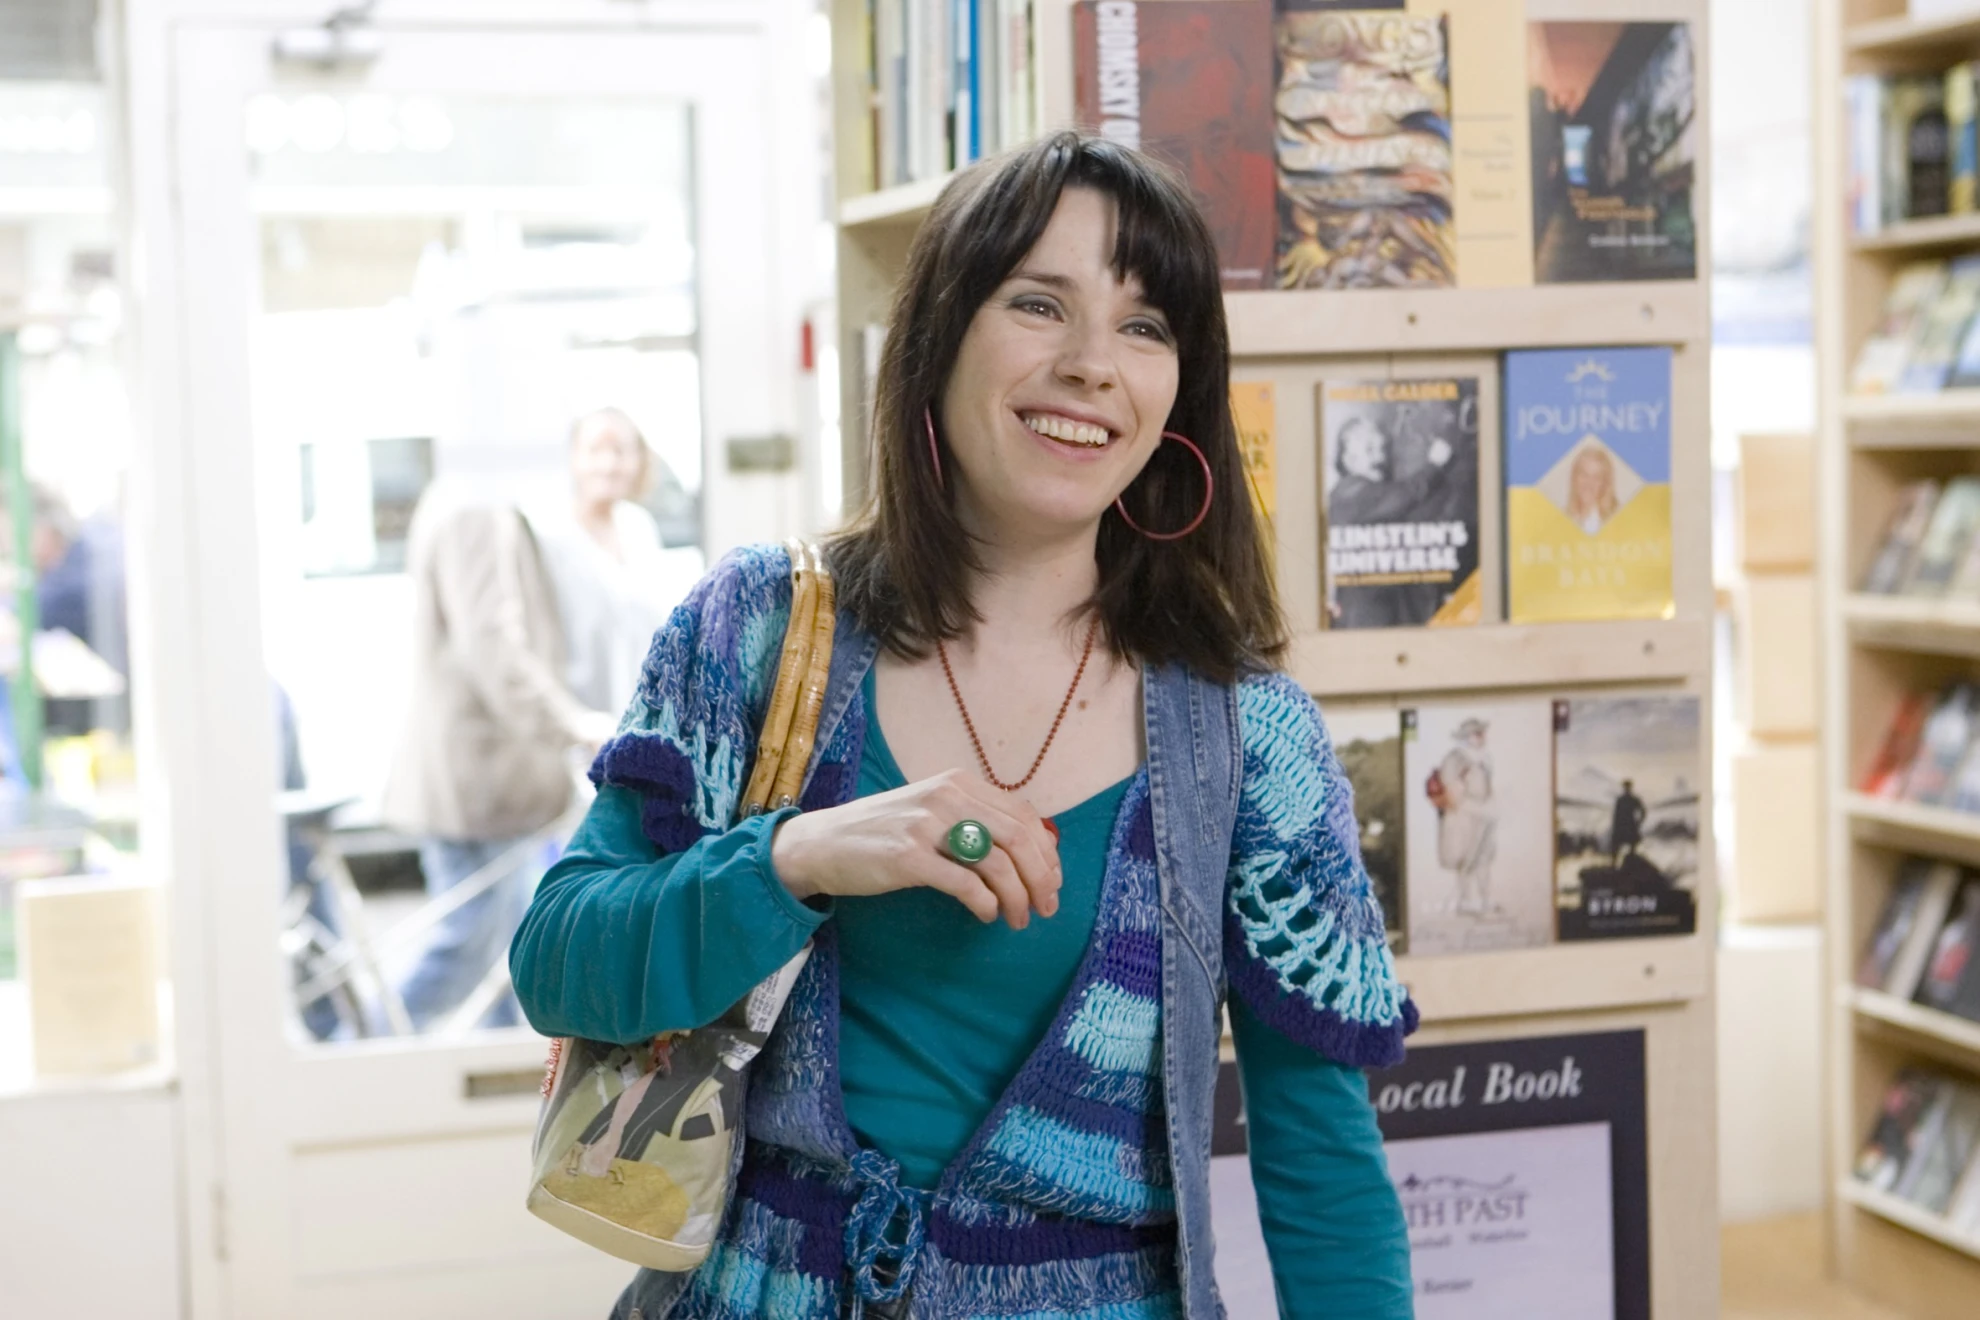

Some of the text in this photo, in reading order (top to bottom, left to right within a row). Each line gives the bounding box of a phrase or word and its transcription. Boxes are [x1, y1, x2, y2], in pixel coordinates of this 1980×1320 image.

[1096, 1, 1140, 117] CHOMSKY
[1516, 399, 1665, 440] JOURNEY
[1330, 521, 1468, 548] EINSTEIN'S
[1330, 547, 1460, 574] UNIVERSE
[1588, 894, 1657, 917] BYRON
[1372, 1056, 1582, 1113] ocal Book
[1454, 1192, 1529, 1226] PAST
